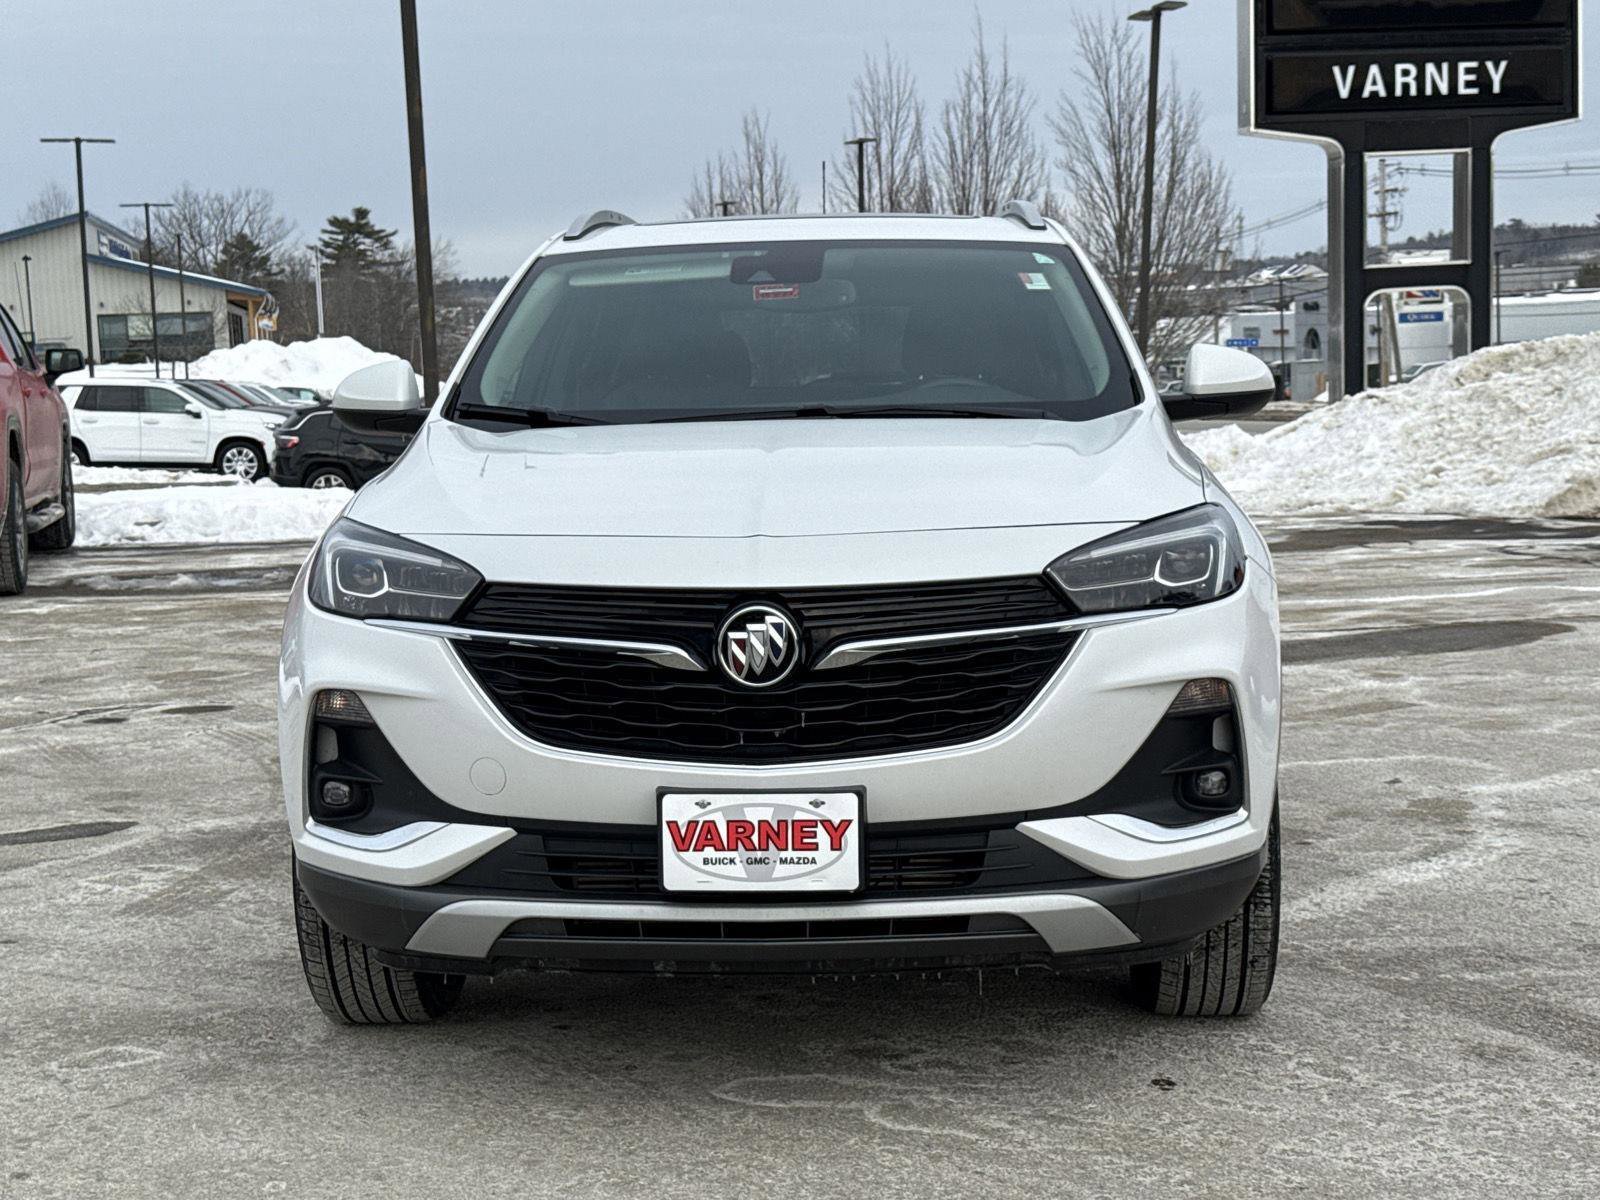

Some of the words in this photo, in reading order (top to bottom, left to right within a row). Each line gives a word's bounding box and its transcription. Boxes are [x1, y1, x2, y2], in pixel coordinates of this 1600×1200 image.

[1331, 60, 1509, 99] VARNEY
[665, 819, 854, 852] VARNEY
[702, 856, 738, 866] BUICK
[746, 856, 771, 866] GMC
[779, 856, 818, 866] MAZDA
